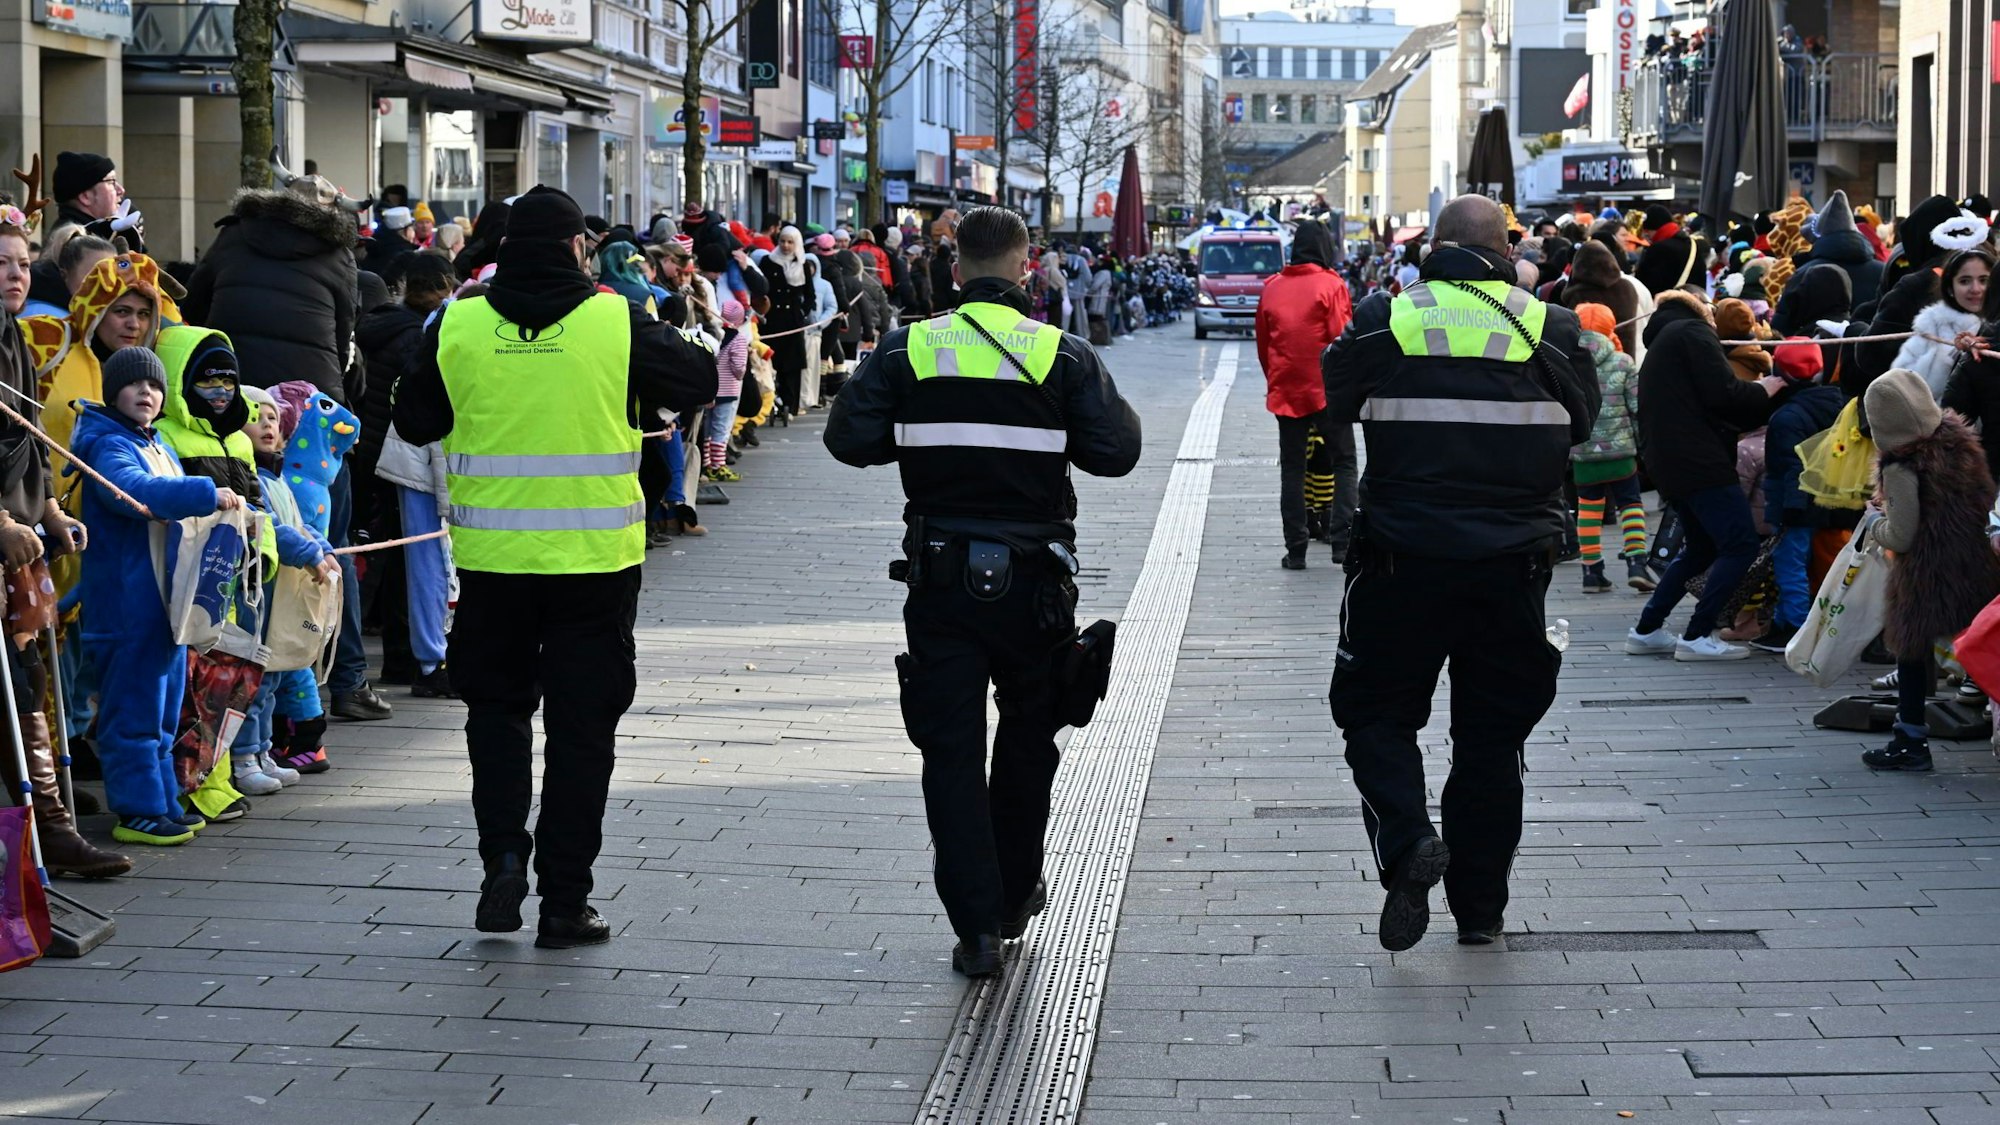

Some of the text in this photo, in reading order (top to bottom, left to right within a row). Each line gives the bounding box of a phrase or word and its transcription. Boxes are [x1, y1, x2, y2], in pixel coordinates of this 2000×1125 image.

[525, 8, 556, 26] Mode
[1015, 0, 1037, 131] WOOLWOR
[751, 147, 792, 156] Tamaris
[1579, 159, 1608, 181] PHONE
[1620, 157, 1662, 180] COMP
